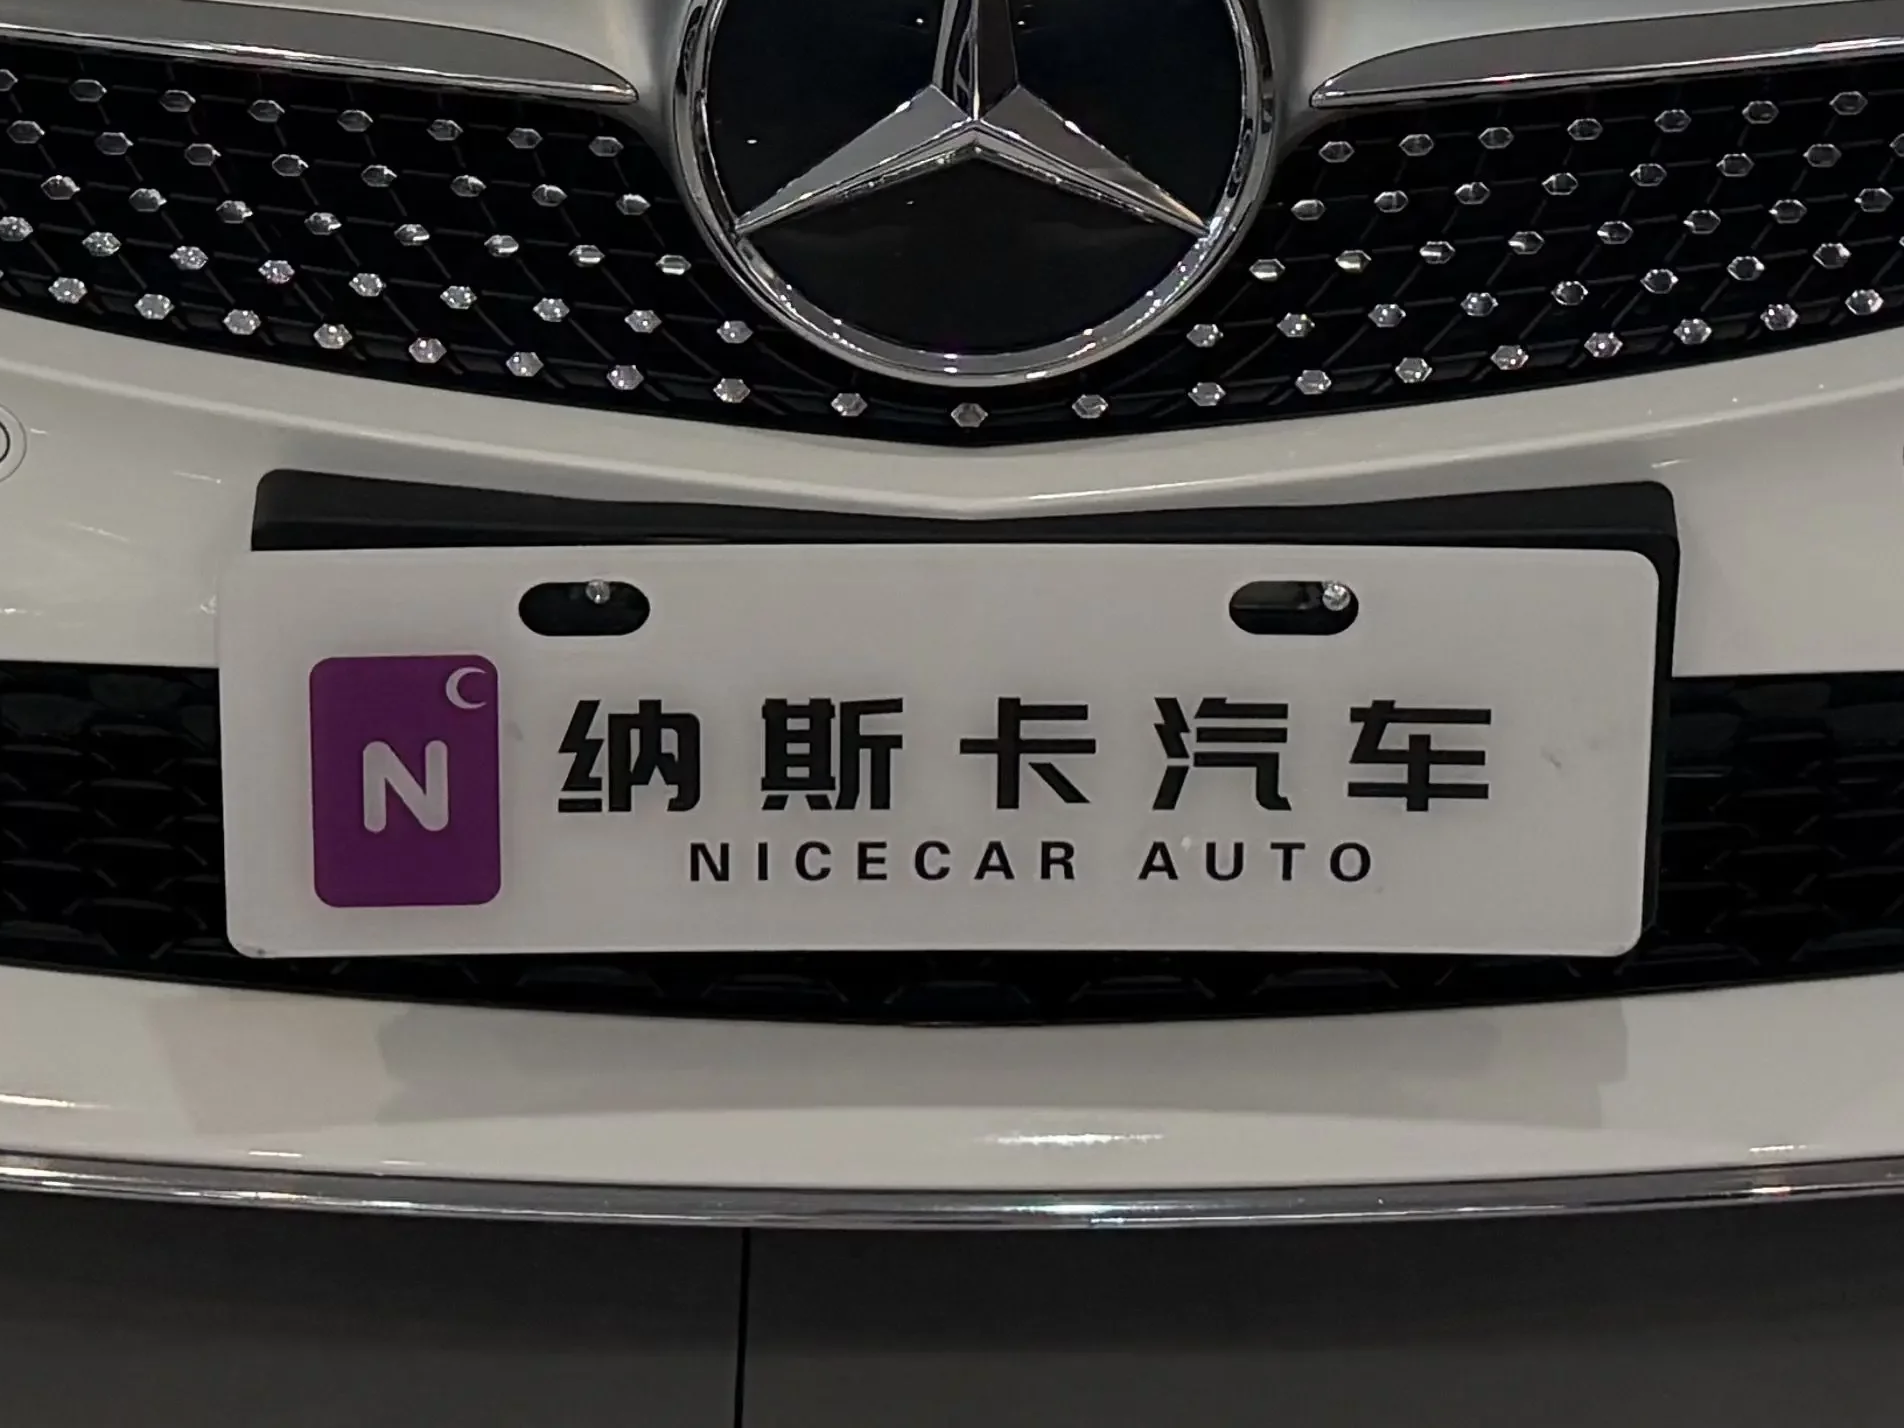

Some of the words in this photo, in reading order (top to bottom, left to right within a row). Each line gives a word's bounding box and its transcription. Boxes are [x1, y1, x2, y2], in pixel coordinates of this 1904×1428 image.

[362, 739, 449, 834] N
[557, 696, 1492, 813] 纳斯卡汽车
[689, 840, 1076, 882] NICECAR
[1137, 840, 1372, 882] AUTO
